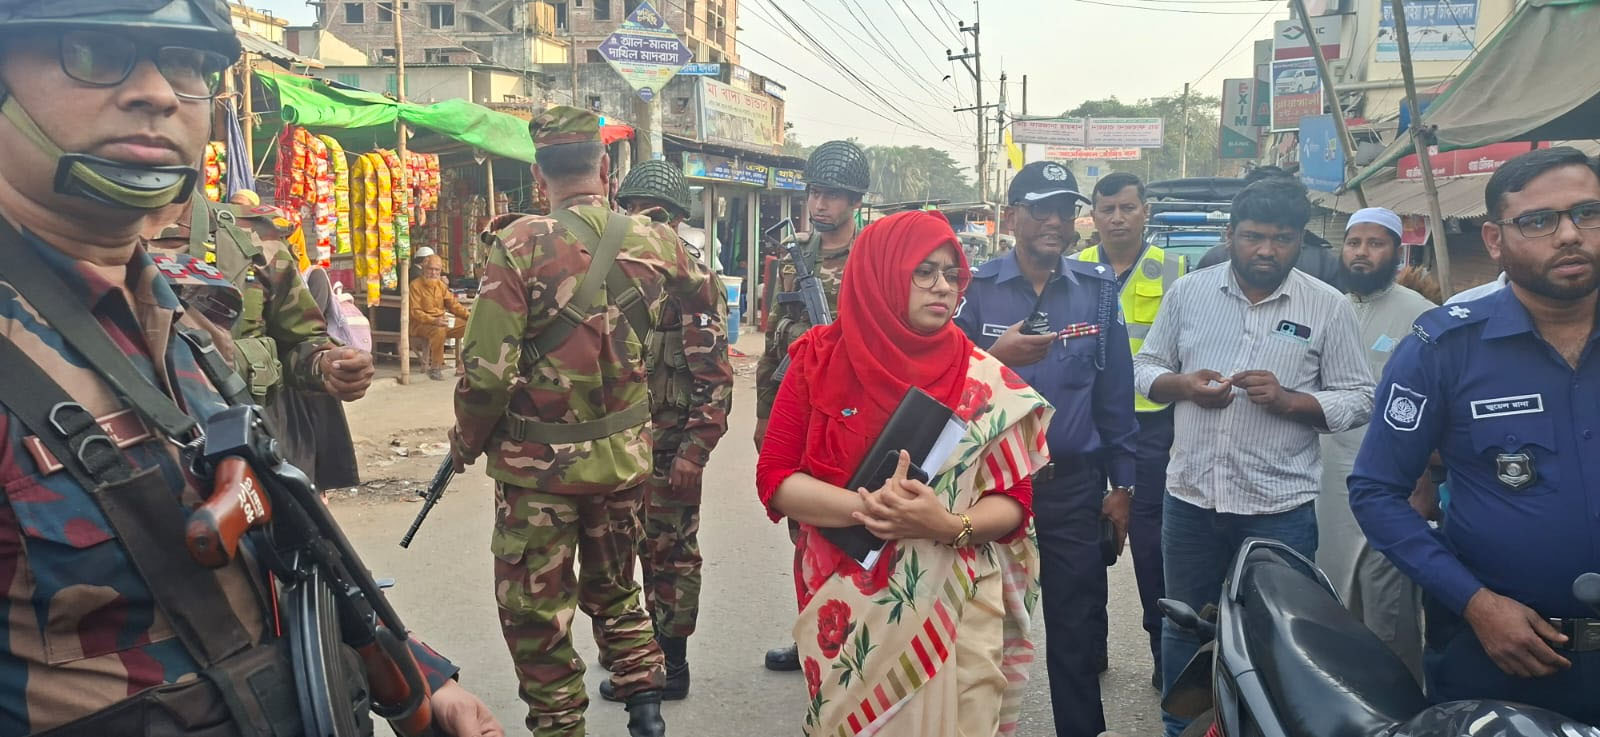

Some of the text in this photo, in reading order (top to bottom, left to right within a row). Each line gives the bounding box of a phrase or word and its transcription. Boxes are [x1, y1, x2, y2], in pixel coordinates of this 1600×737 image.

[620, 36, 678, 50] আল-মানার
[609, 46, 679, 62] দাখিল মাদরাসা
[706, 82, 717, 97] মা
[721, 88, 740, 104] খাদ্য
[1234, 83, 1248, 126] EXIM
